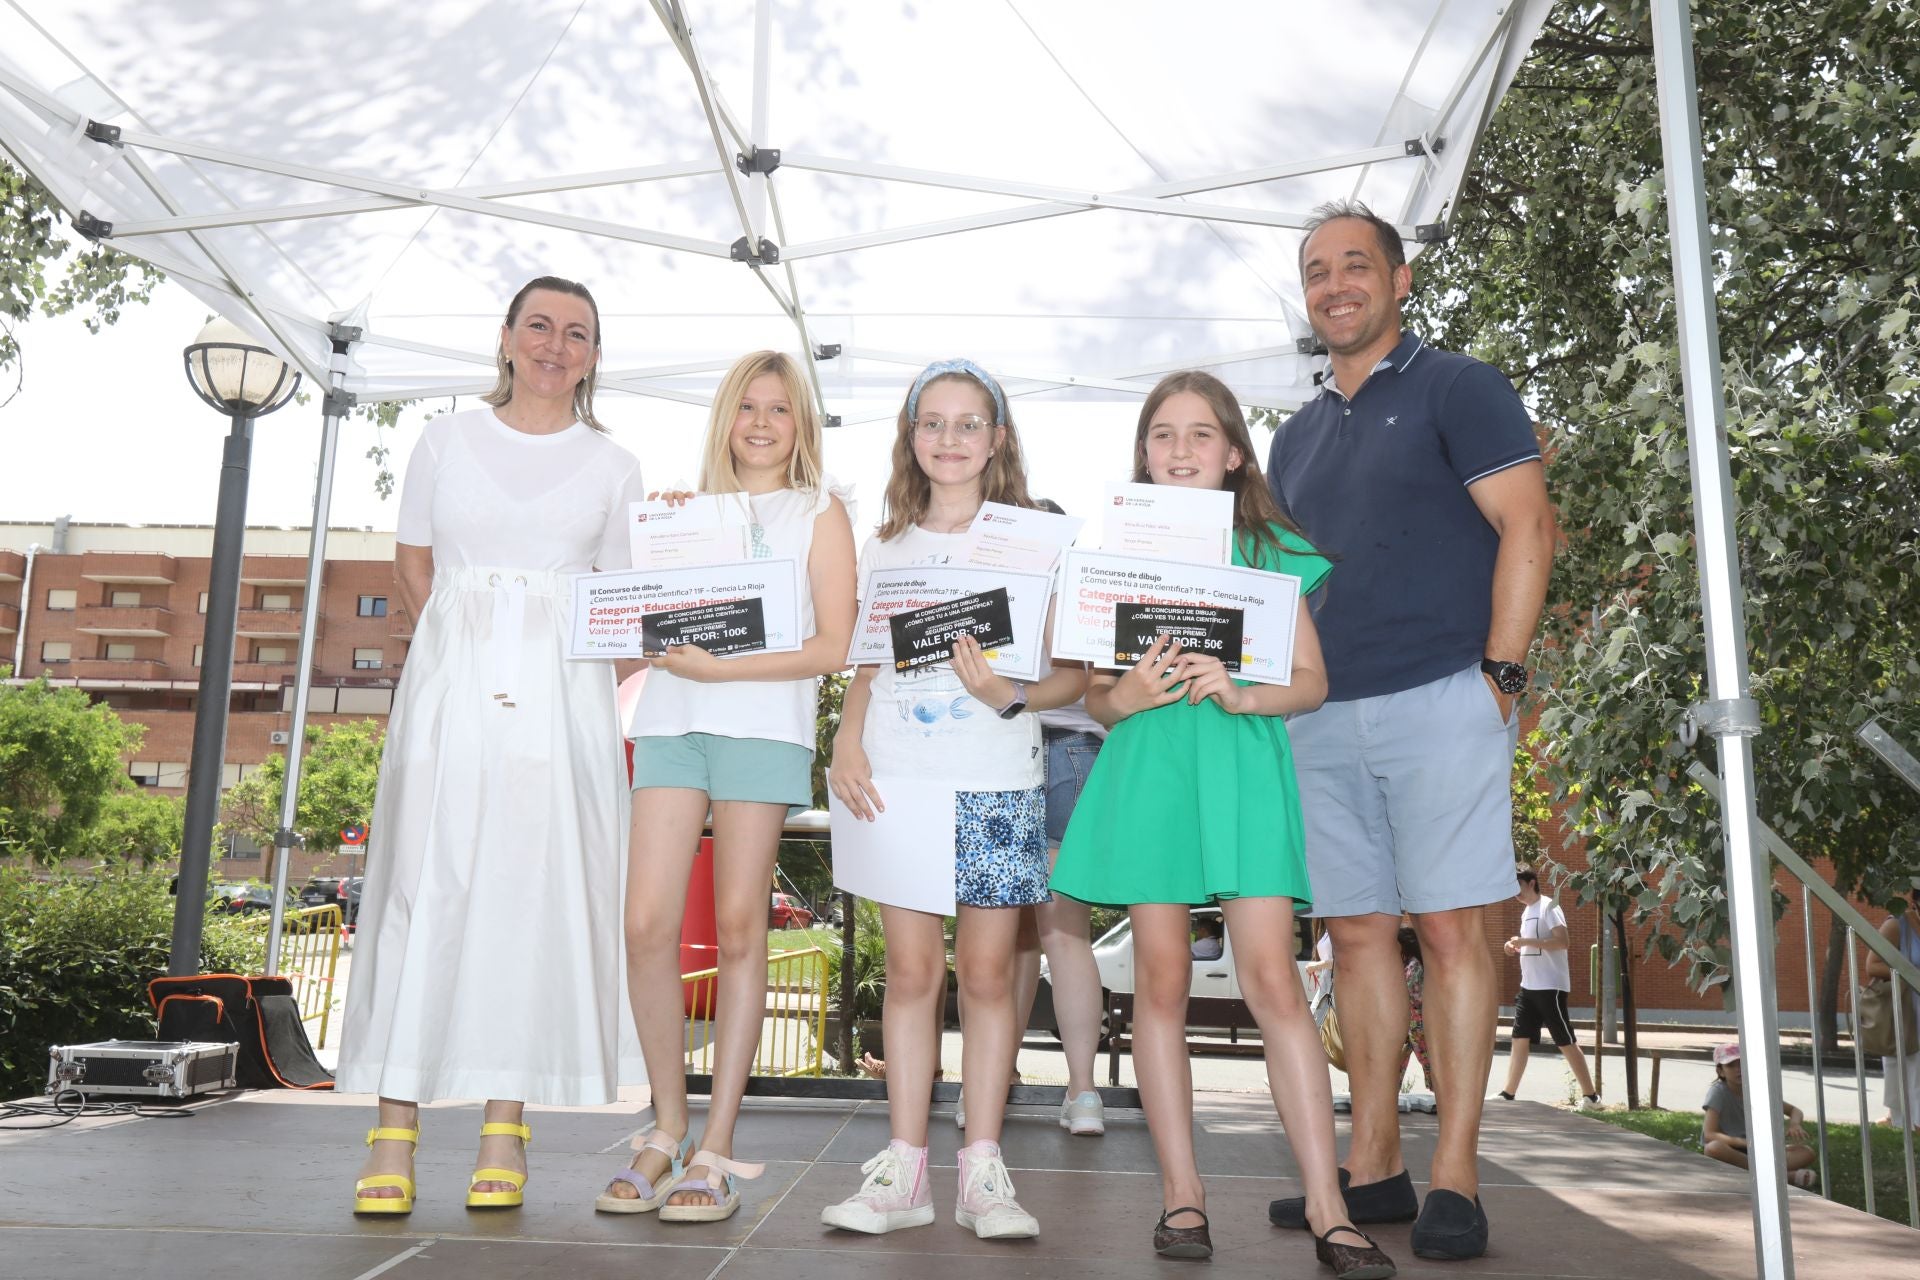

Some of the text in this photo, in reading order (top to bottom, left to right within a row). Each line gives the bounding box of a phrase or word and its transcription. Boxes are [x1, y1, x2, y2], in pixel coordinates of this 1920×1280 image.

[1090, 568, 1126, 578] Concurso
[1139, 572, 1162, 582] dibujo
[598, 586, 630, 594] Concurso
[712, 584, 737, 593] Ciencia
[1080, 588, 1134, 603] Categoría
[1213, 590, 1238, 601] Ciencia
[1249, 596, 1264, 606] Rioja
[590, 605, 640, 616] Categoría
[872, 601, 903, 610] Categoría
[921, 605, 950, 617] CONCURSO
[960, 598, 979, 607] DIBUJO
[1078, 602, 1112, 613] Tercer
[674, 608, 704, 618] CONCURSO
[589, 617, 625, 625] Primer
[1077, 615, 1100, 625] Vale
[588, 627, 610, 635] Vale
[612, 628, 630, 636] por
[866, 625, 879, 633] Vale
[925, 624, 953, 636] SEGUNDO
[954, 619, 976, 628] PREMIO
[661, 627, 748, 646] VALE POR: 100€
[913, 634, 941, 649] VALE
[972, 622, 992, 634] 75€
[1204, 640, 1223, 649] 50€
[896, 650, 949, 668] e:scala
